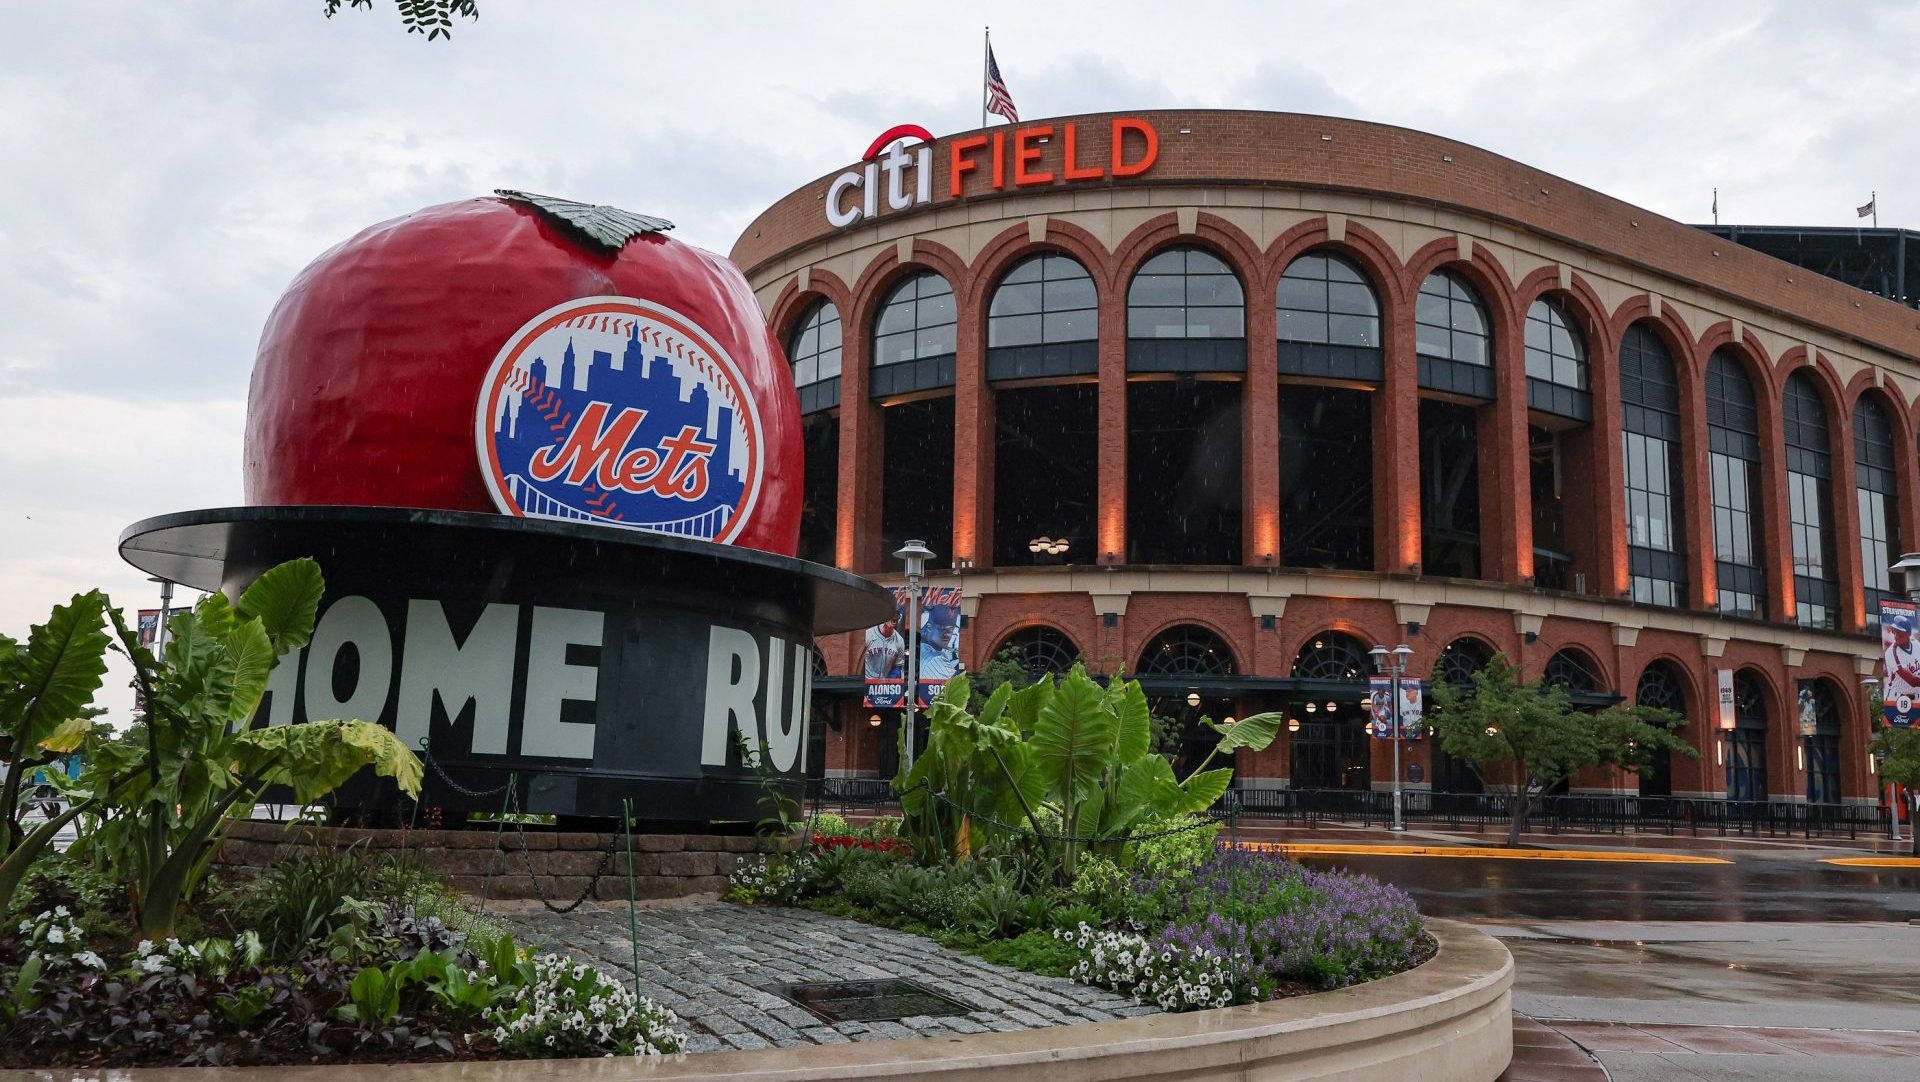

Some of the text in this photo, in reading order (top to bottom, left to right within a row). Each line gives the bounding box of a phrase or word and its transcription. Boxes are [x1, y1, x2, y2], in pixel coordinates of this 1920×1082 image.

[825, 118, 1159, 227] citi FIELD
[528, 400, 717, 501] Mets
[1882, 606, 1916, 616] STRAWBERRY
[701, 625, 812, 773] RU
[868, 684, 901, 696] ALONSO
[1900, 700, 1908, 708] 18
